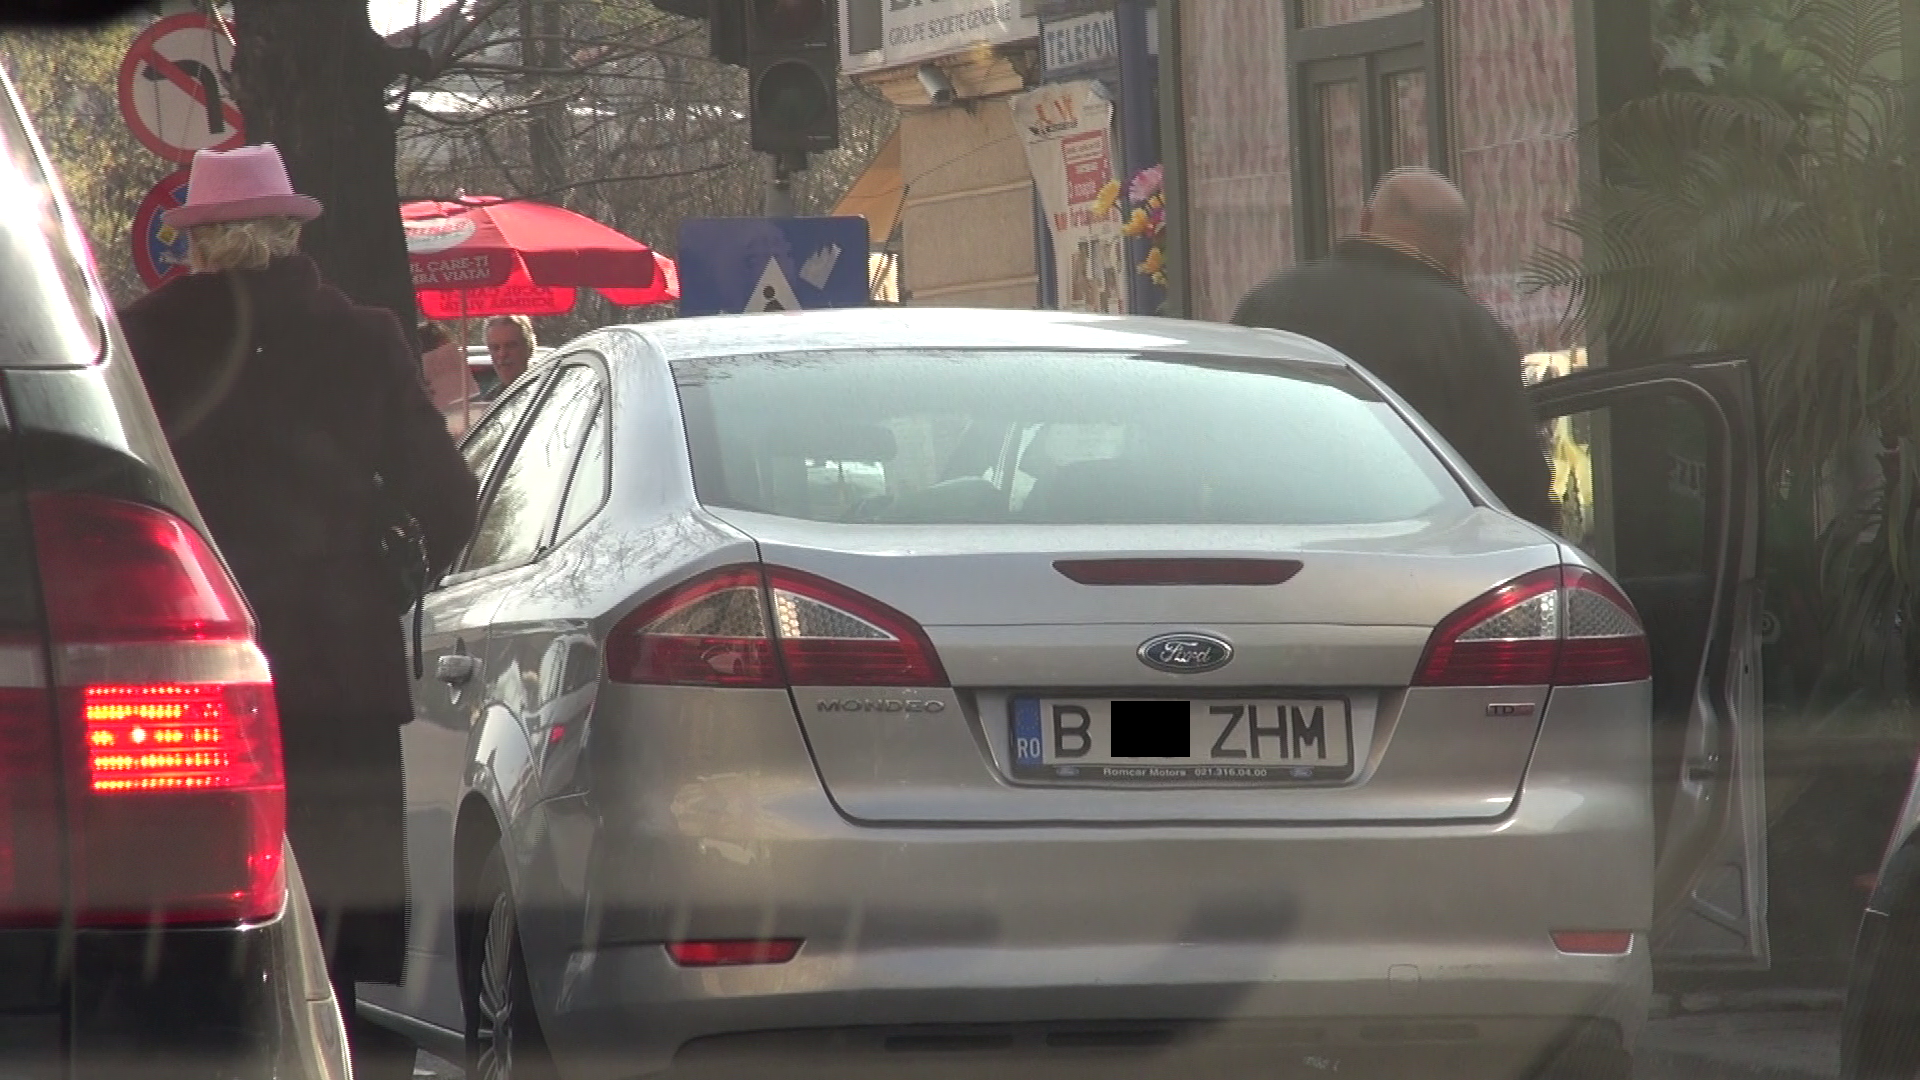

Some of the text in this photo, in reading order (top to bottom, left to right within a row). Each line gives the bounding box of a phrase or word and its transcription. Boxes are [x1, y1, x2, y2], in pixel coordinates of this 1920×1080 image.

[889, 21, 926, 47] GROUPE
[928, 12, 966, 39] SOCIETE
[1046, 17, 1116, 67] TELEFON
[1159, 640, 1212, 663] Ford
[816, 699, 946, 713] MONDEO
[1052, 704, 1327, 760] B ZHM
[1017, 738, 1041, 759] RO
[1103, 767, 1146, 777] Romcar
[1150, 767, 1187, 777] Motors
